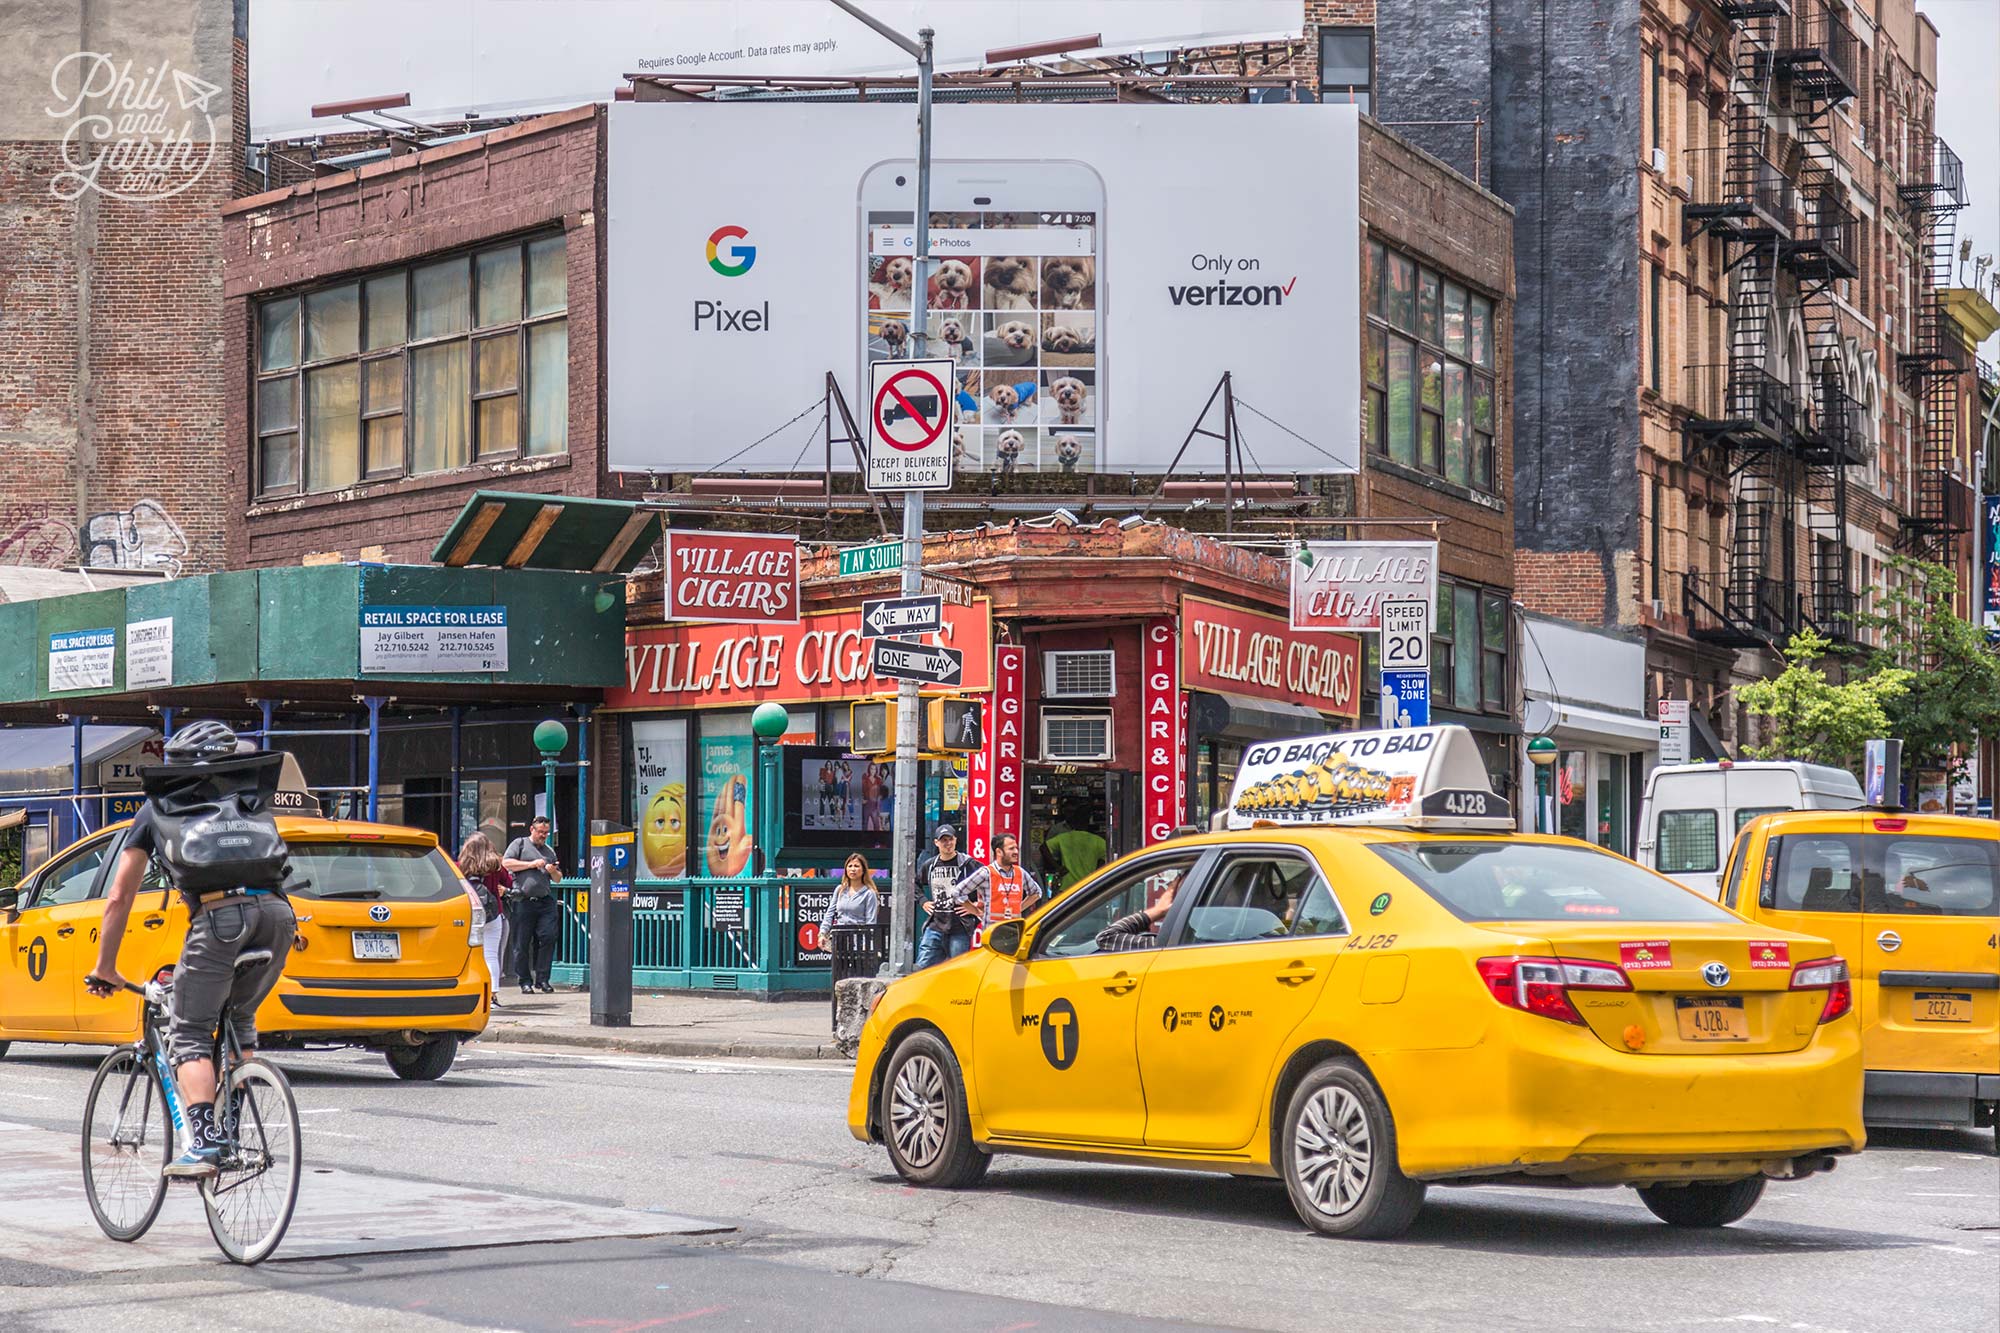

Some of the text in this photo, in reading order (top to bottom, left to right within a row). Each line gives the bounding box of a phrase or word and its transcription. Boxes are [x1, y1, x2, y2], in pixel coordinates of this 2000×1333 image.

[638, 38, 839, 70] Requires Google Account. Data rates may apply.
[1075, 214, 1092, 223] 7:00
[903, 236, 971, 249] Gle Photos
[1191, 253, 1260, 274] Only on
[1168, 279, 1282, 306] verizon
[694, 300, 769, 332] Pixel
[872, 456, 947, 468] EXCEPT DELIVERIES
[881, 471, 937, 482] THIS BLOCK
[676, 547, 793, 578] VILLAGE
[843, 546, 901, 573] 7 AV SOUTH
[1303, 555, 1430, 584] VILLAGE
[677, 578, 792, 616] CIGARS
[964, 586, 972, 607] ST
[364, 612, 503, 624] RETAIL SPACE FOR LEASE
[874, 608, 931, 626] ONE WAY
[1386, 606, 1424, 618] SPEED
[1389, 621, 1421, 632] LIMIT
[97, 634, 114, 646] LEASE
[378, 631, 496, 642] Jay Gilbert Jansen Hafen
[374, 642, 495, 651] 212.710.5242 212.710.5245
[1388, 636, 1422, 660] 20
[625, 634, 784, 693] VILLAGE
[881, 651, 952, 673] ONE WAY
[1193, 619, 1353, 707] VILLAGE CIGARS
[1150, 625, 1170, 739] CIGAR
[1400, 680, 1425, 689] SLOW
[1400, 690, 1425, 700] ZONE
[999, 654, 1018, 758] CIGAR
[638, 747, 652, 763] T.J.
[705, 744, 734, 759] James
[1247, 732, 1434, 766] GO BACK TO BAD
[705, 761, 740, 774] Corden
[1179, 700, 1188, 823] CANDY
[639, 765, 667, 778] Miller
[641, 782, 648, 795] is
[707, 781, 715, 793] is
[274, 792, 302, 807] 8K78
[512, 793, 527, 806] 108
[1446, 794, 1487, 814] 4J28
[615, 848, 625, 866] P
[632, 893, 659, 911] bway
[1347, 934, 1399, 950] 4J28
[1021, 1014, 1040, 1027] NYC
